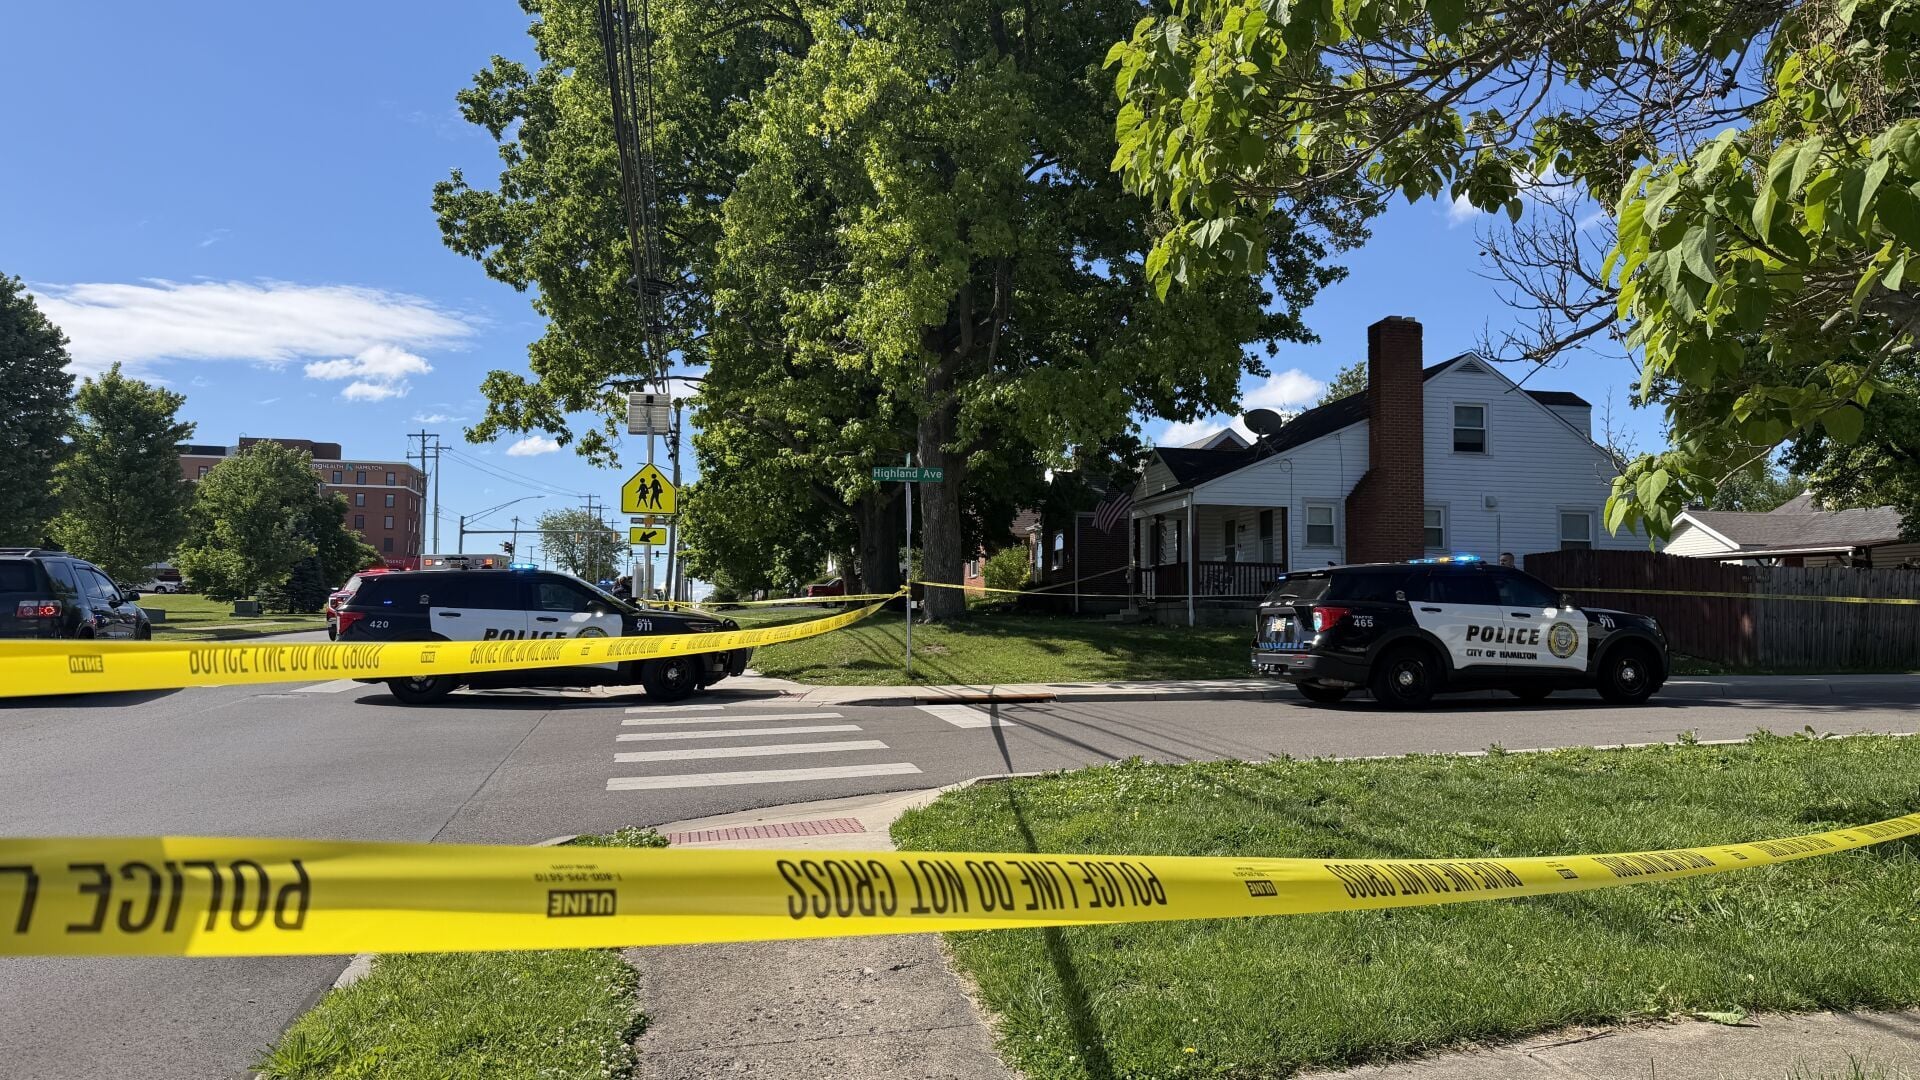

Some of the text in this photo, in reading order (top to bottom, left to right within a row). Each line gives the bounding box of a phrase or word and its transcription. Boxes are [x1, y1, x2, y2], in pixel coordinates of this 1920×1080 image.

[873, 468, 942, 480] Highland Ave
[370, 620, 389, 629] 420
[636, 622, 653, 632] 911
[1353, 619, 1374, 628] 465
[1599, 618, 1615, 628] 911
[1466, 624, 1540, 646] POLICE
[1466, 648, 1538, 660] CITY OF HAMILTON
[1324, 864, 1396, 899] CROSS
[1377, 863, 1430, 896] NOT
[1409, 863, 1451, 894] DO
[1458, 861, 1524, 890] POLICE
[65, 859, 311, 934] POLICE
[776, 858, 1168, 920] POLICE LINE DO NOT CROSS
[1247, 881, 1276, 895] ULINE
[551, 891, 614, 916] ULINE
